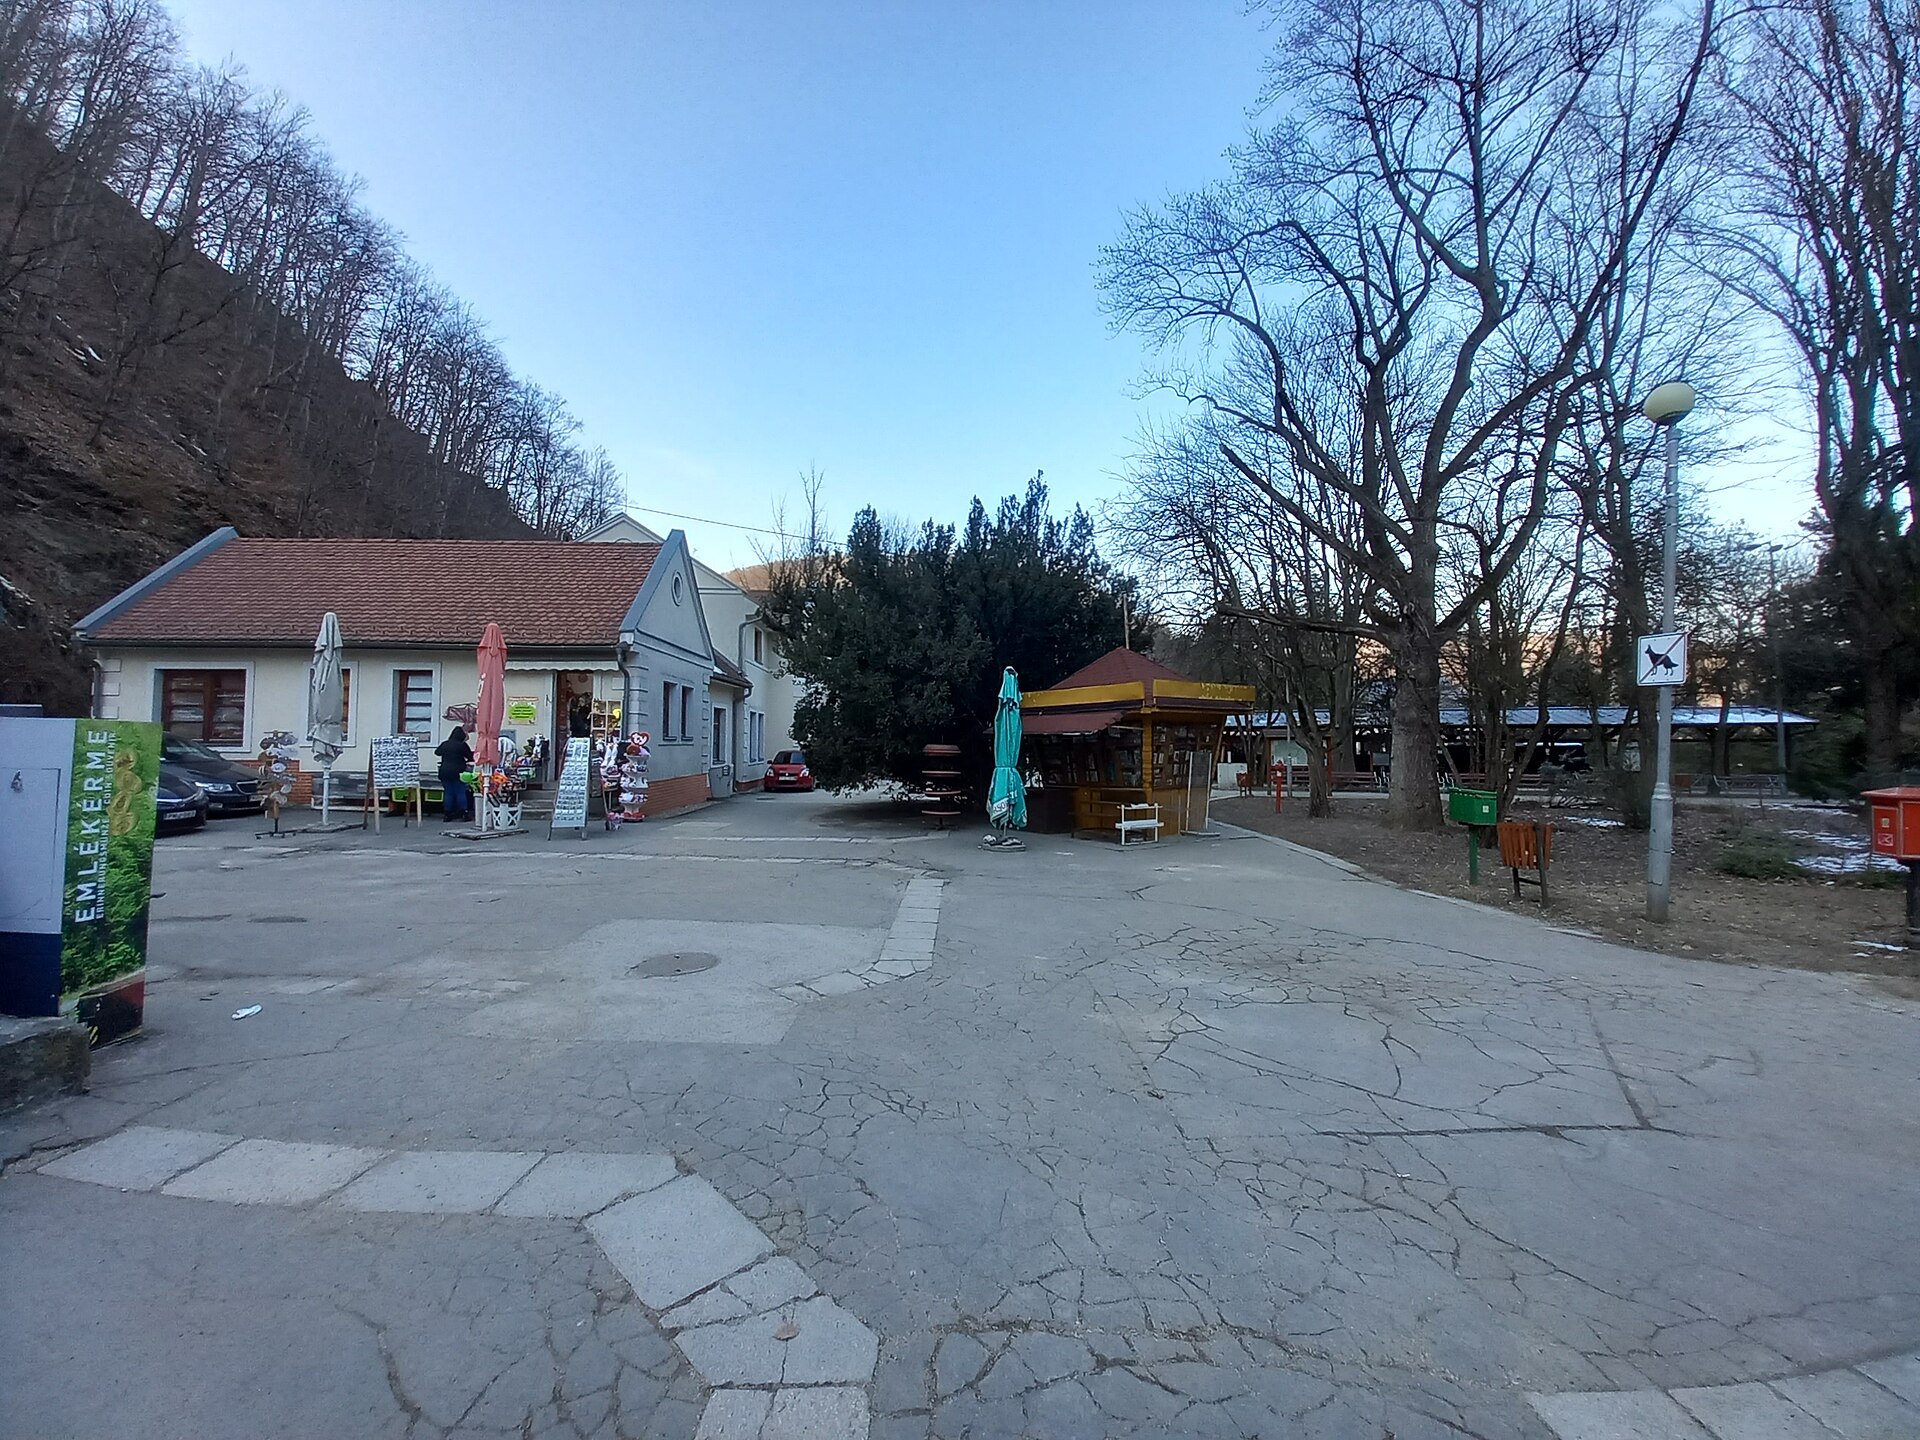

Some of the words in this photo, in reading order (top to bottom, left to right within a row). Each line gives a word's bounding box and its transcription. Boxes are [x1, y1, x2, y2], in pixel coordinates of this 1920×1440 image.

[105, 731, 116, 779] SOUVENIR
[104, 782, 113, 805] COIN
[73, 731, 107, 922] EMLÉKÉRME
